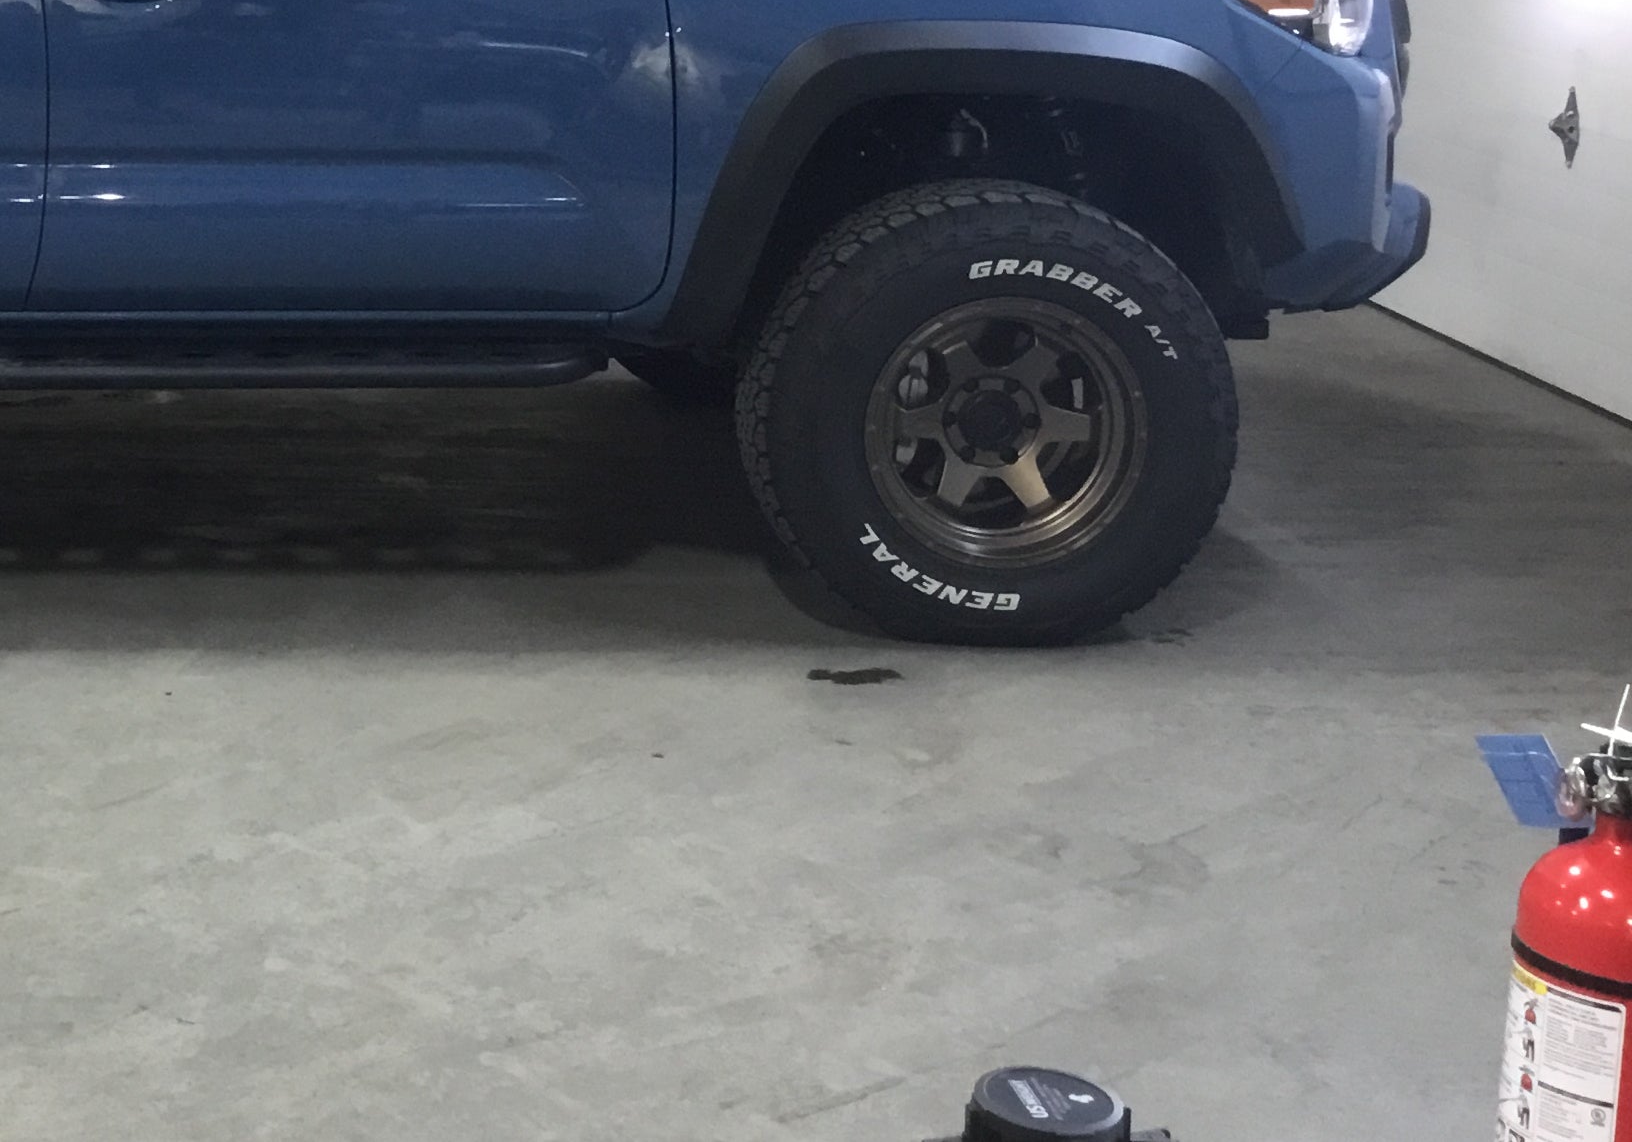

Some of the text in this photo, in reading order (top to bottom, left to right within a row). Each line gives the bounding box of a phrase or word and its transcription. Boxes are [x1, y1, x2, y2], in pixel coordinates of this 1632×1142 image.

[968, 258, 1179, 360] GRABBER A/T
[858, 522, 1021, 611] GENERAL
